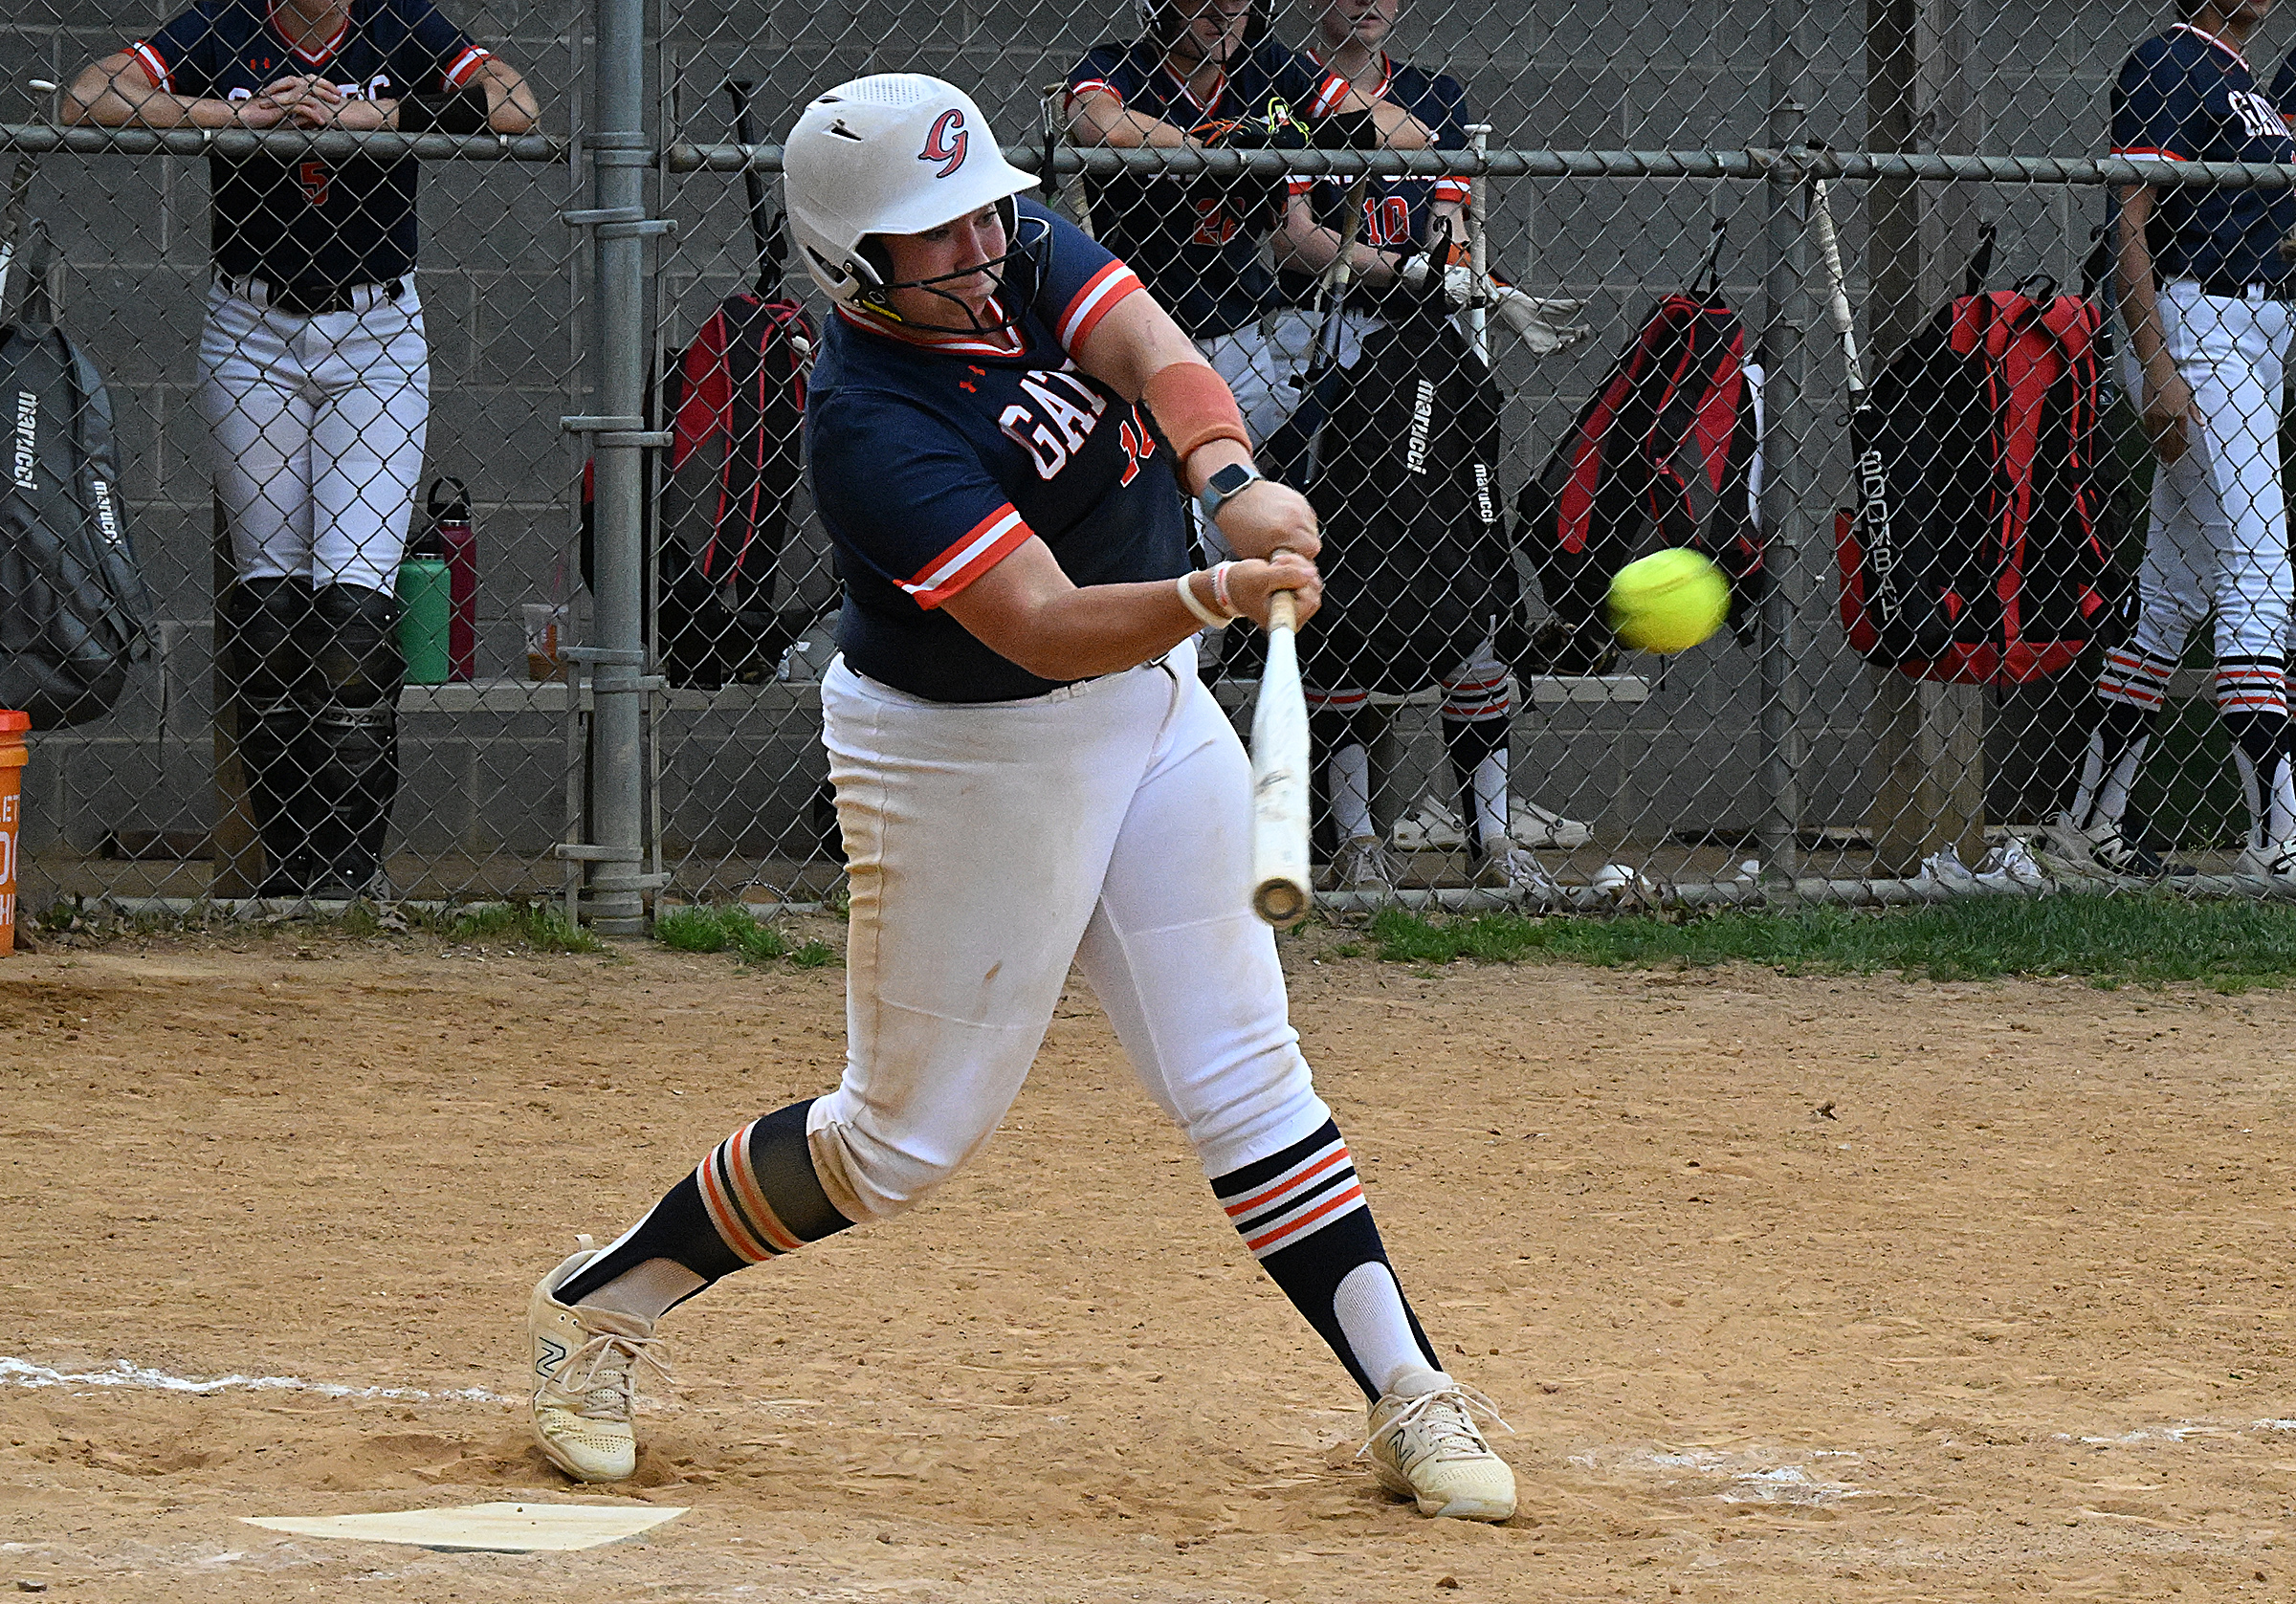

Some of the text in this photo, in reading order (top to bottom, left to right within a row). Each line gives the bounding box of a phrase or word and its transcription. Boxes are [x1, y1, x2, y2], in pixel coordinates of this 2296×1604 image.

[918, 108, 968, 178] G
[299, 161, 329, 207] 5
[1362, 196, 1410, 246] 10
[14, 390, 38, 491] marucci
[1406, 379, 1434, 475] marucci
[94, 480, 122, 545] marucci
[1473, 463, 1497, 524] marucci
[1861, 450, 1902, 622] BOOMBAH
